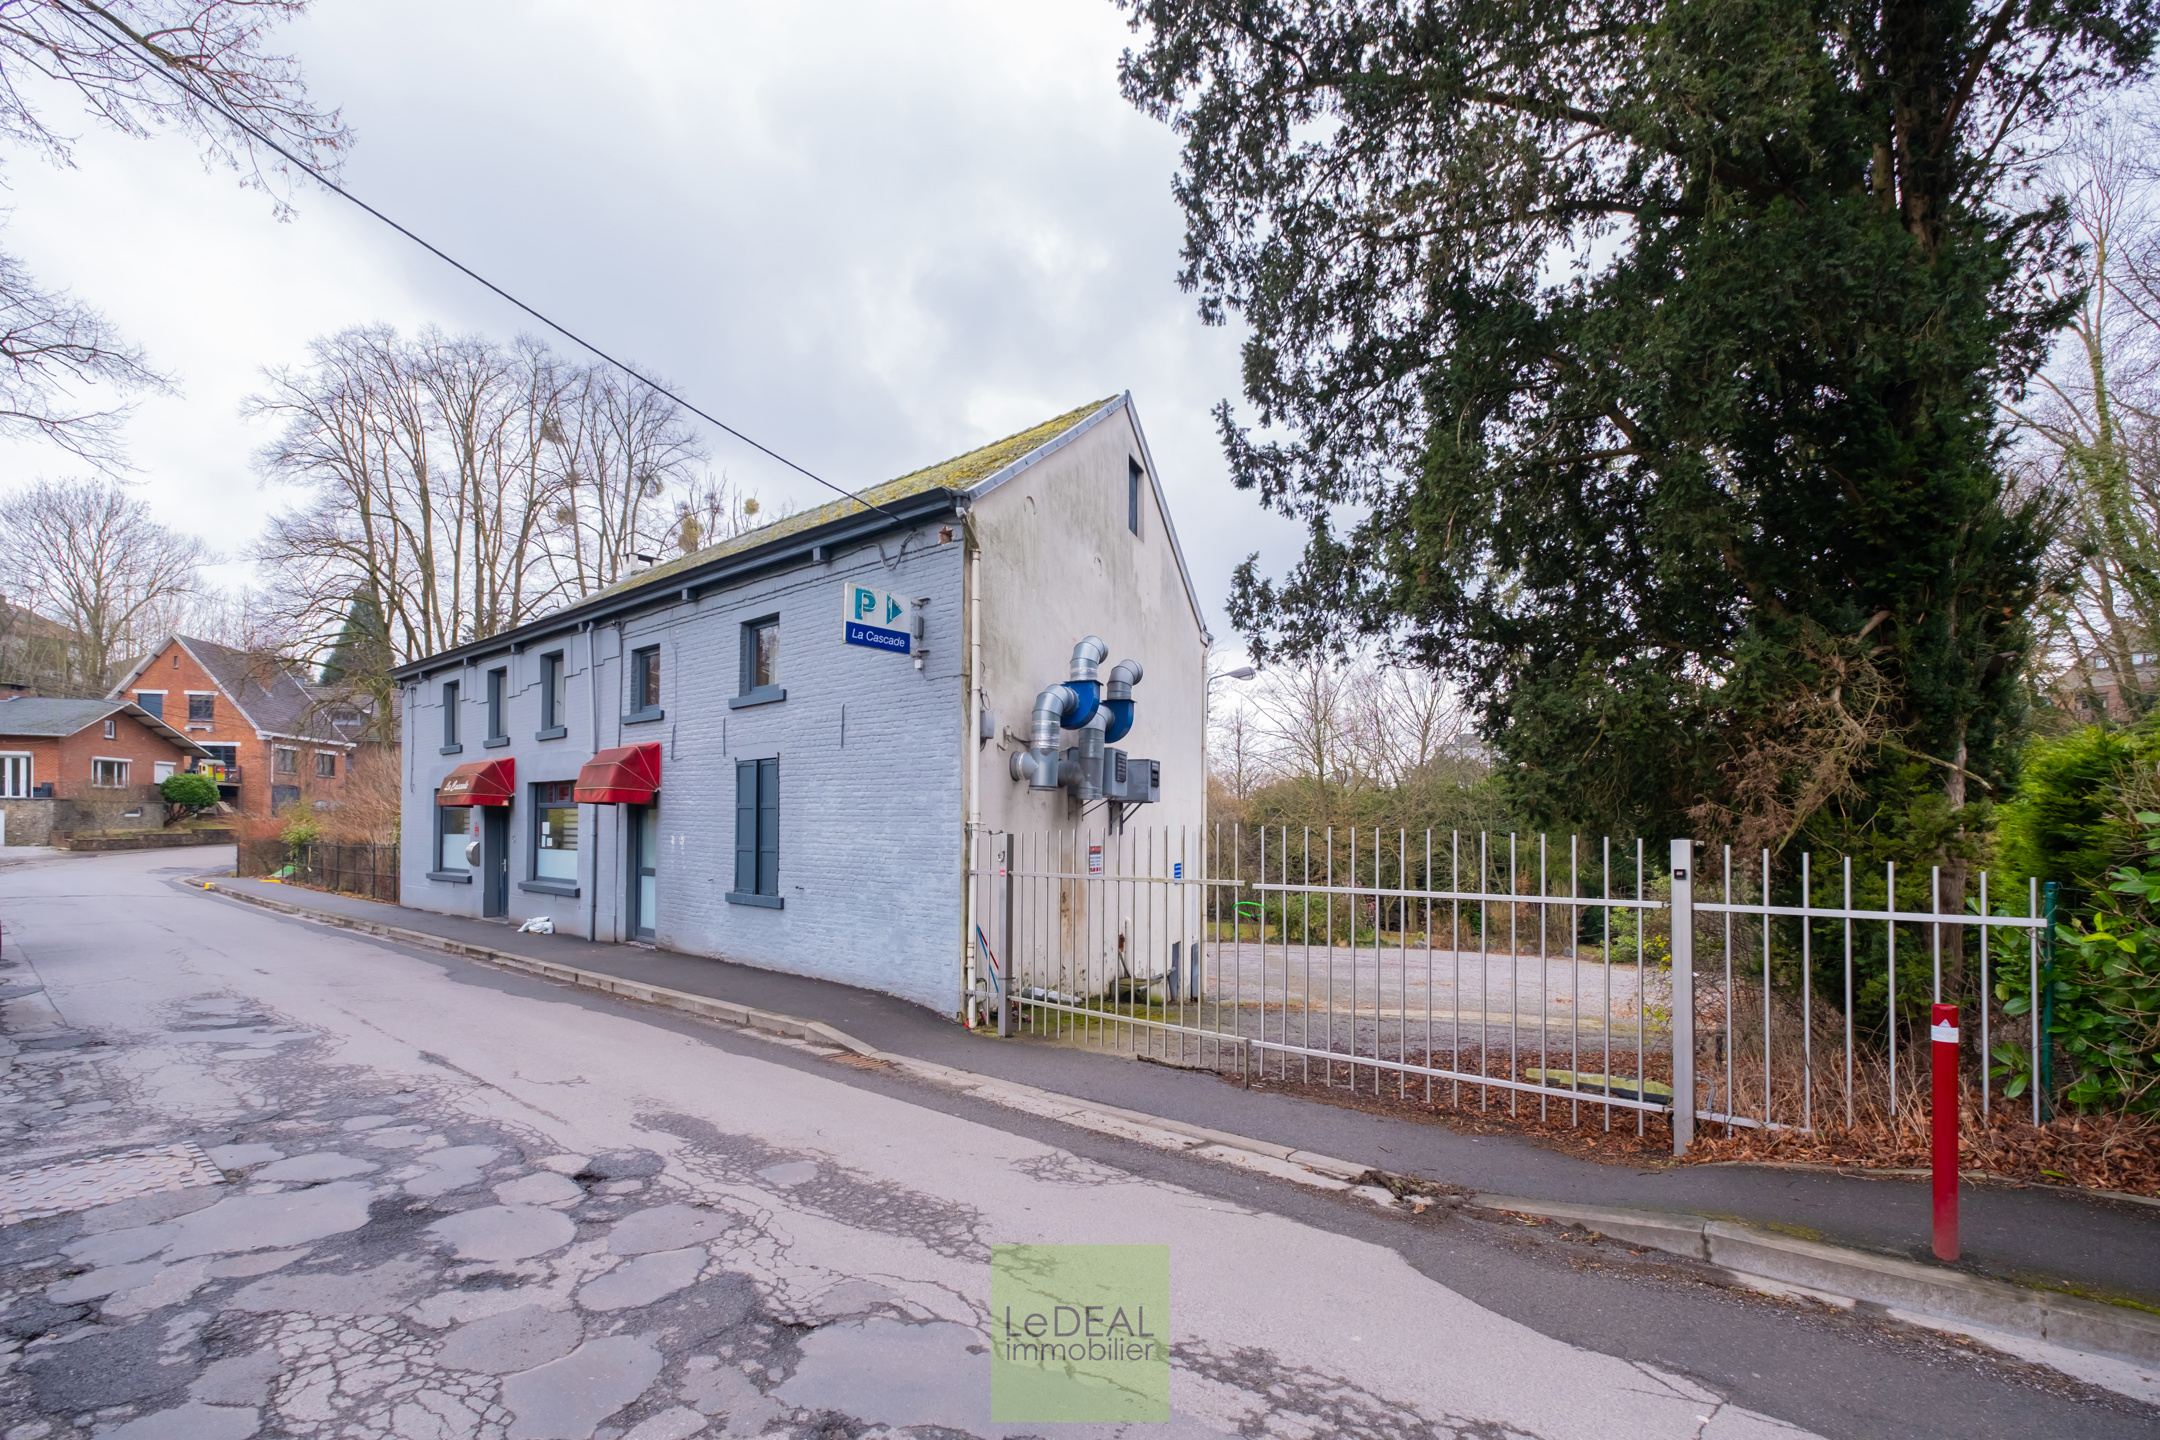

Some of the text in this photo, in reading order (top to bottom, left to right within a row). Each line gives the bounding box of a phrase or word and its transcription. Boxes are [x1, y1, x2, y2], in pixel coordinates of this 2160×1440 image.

[855, 588, 876, 620] P
[852, 628, 905, 647] La Cascade
